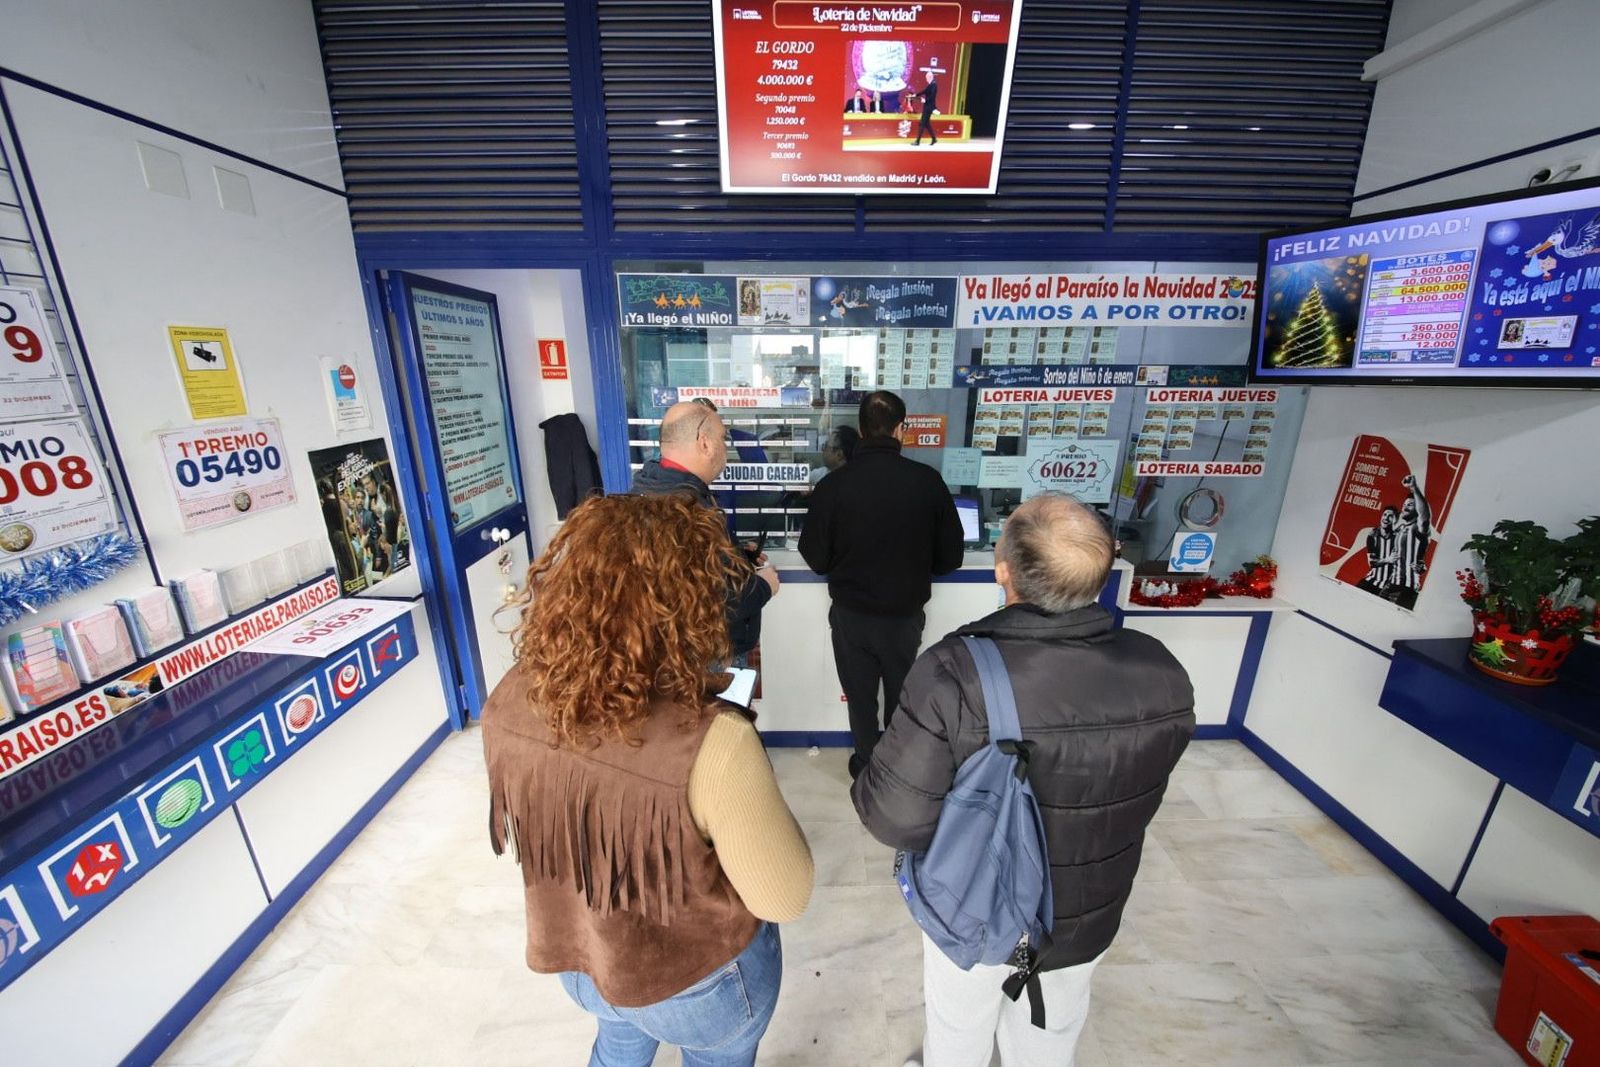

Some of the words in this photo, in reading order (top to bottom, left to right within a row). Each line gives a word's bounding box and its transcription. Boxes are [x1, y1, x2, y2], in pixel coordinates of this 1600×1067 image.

[812, 7, 855, 23] Lotería
[856, 8, 871, 21] de
[872, 5, 922, 21] Navidad
[755, 41, 770, 54] EL
[772, 41, 814, 54] GORDO
[772, 60, 798, 70] 79432
[757, 75, 804, 86] 4.000.000
[806, 75, 814, 86] €
[755, 92, 788, 104] Segundo
[788, 92, 816, 104] premio
[782, 174, 790, 182] El
[792, 174, 816, 182] Gordo
[818, 174, 842, 182] 79432
[844, 174, 876, 182] vendido
[888, 174, 915, 182] Madrid
[924, 174, 946, 184] León.
[1274, 236, 1341, 261] ¡FELIZ
[1348, 216, 1471, 248] NAVIDAD!
[1396, 254, 1447, 266] BOTES
[1410, 264, 1470, 276] 3.600.000
[1402, 274, 1468, 285] 40.000.000
[866, 284, 900, 304] ¡Regala
[902, 280, 934, 296] ilusión!
[965, 278, 988, 300] Ya
[992, 276, 1031, 302] llegó
[1036, 276, 1052, 299] al
[1056, 276, 1119, 298] Paraíso
[1122, 276, 1140, 298] la
[1143, 276, 1217, 298] Navidad
[1400, 282, 1466, 295] 64.500.000
[1483, 282, 1498, 306] Ya
[1500, 282, 1530, 306] está
[1530, 272, 1566, 304] aquí
[1565, 268, 1582, 292] el
[412, 293, 454, 310] NUESTROS
[456, 301, 488, 314] PREMIOS
[1400, 292, 1464, 304] 13.000.000
[625, 312, 644, 326] ¡Ya
[648, 312, 678, 326] llegó
[682, 312, 692, 324] el
[696, 311, 732, 324] NIÑO!
[973, 304, 1073, 324] ¡VAMOS
[1080, 304, 1098, 320] A
[1107, 304, 1160, 320] POR
[1168, 304, 1247, 320] OTRO!
[459, 316, 464, 325] 5
[466, 316, 485, 328] AÑOS
[1412, 322, 1458, 332] 360.000
[1401, 332, 1457, 340] 1.290.000
[4, 326, 44, 363] 9
[1417, 340, 1456, 348] 12.000
[1043, 367, 1066, 384] Sorteo
[1068, 368, 1078, 384] del
[1080, 367, 1096, 384] Niño
[1098, 368, 1102, 384] 6
[1104, 368, 1112, 384] de
[1113, 371, 1133, 385] enero
[984, 390, 1048, 402] LOTERIA
[1053, 390, 1114, 402] JUEVES
[1149, 390, 1214, 402] LOTERIA
[1218, 390, 1276, 402] JUEVES
[194, 432, 268, 456] PREMIO
[920, 436, 930, 444] 10
[934, 436, 939, 444] €
[176, 446, 281, 487] 05490
[726, 466, 764, 480] CIUDAD
[1040, 461, 1098, 478] 60622
[1140, 464, 1200, 474] LOTERIA
[1204, 464, 1262, 474] SABADO
[1355, 462, 1379, 474] SOMOS
[1378, 466, 1389, 477] DE
[1348, 484, 1371, 497] SOMOS
[1371, 489, 1381, 499] DE
[1344, 493, 1353, 503] LA
[1352, 495, 1382, 511] QUINIELA
[161, 578, 338, 683] WWW.LOTERIAELPARAISO.ES
[292, 607, 374, 645] 90693
[0, 695, 106, 774] RAISO.ES
